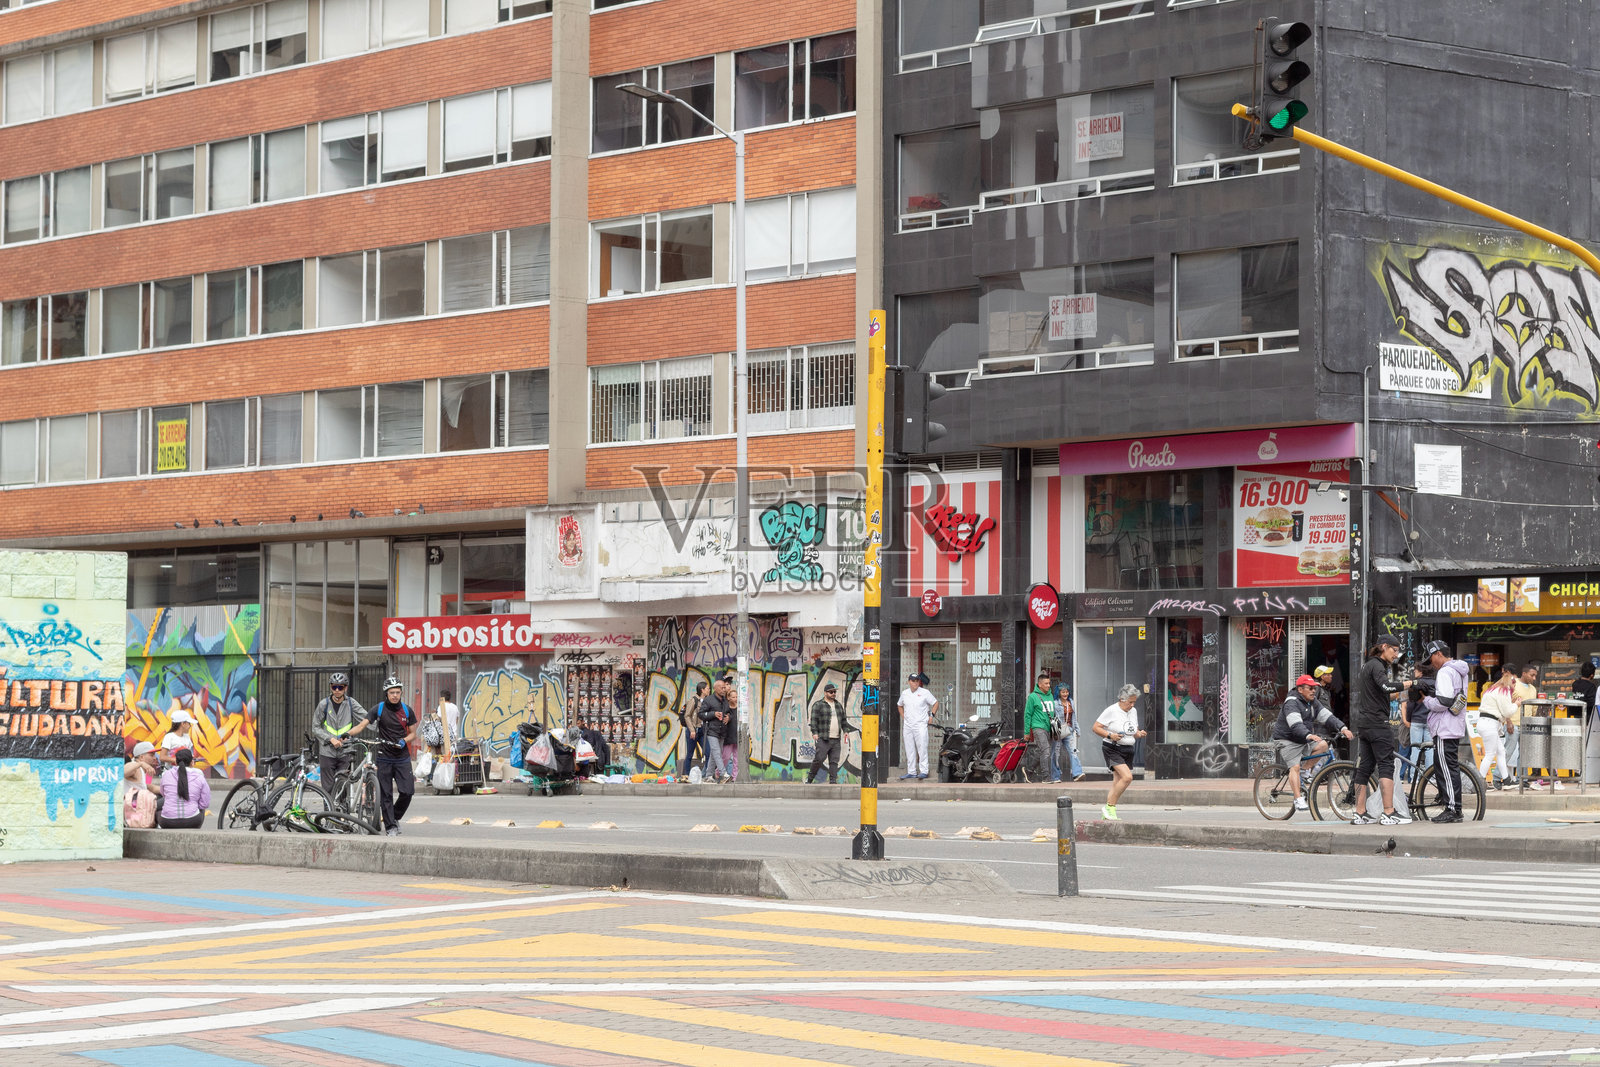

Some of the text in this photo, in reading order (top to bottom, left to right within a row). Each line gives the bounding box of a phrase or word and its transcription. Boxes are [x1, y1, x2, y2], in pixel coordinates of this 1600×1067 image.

[1078, 116, 1121, 138] SE ARRIENDA
[1051, 296, 1094, 316] SE ARRIENDA
[1389, 373, 1424, 388] PARQUEE
[1425, 377, 1441, 391] CON
[1128, 441, 1176, 469] Presto
[1309, 461, 1342, 473] ADICTOS
[1240, 479, 1310, 508] 16.900
[558, 520, 579, 536] NEWS
[560, 515, 574, 527] FAKE
[1309, 529, 1346, 544] 19.900
[1084, 596, 1134, 607] Edificio Coliseum
[386, 618, 541, 649] Sabrosito.
[978, 637, 991, 650] LAS
[967, 651, 1002, 664] CRISPETAS
[972, 664, 996, 677] NO SON
[975, 678, 992, 691] SOLO
[0, 678, 124, 711] LTURA
[971, 692, 997, 705] PARA EL
[54, 765, 119, 784] IDIPRON
